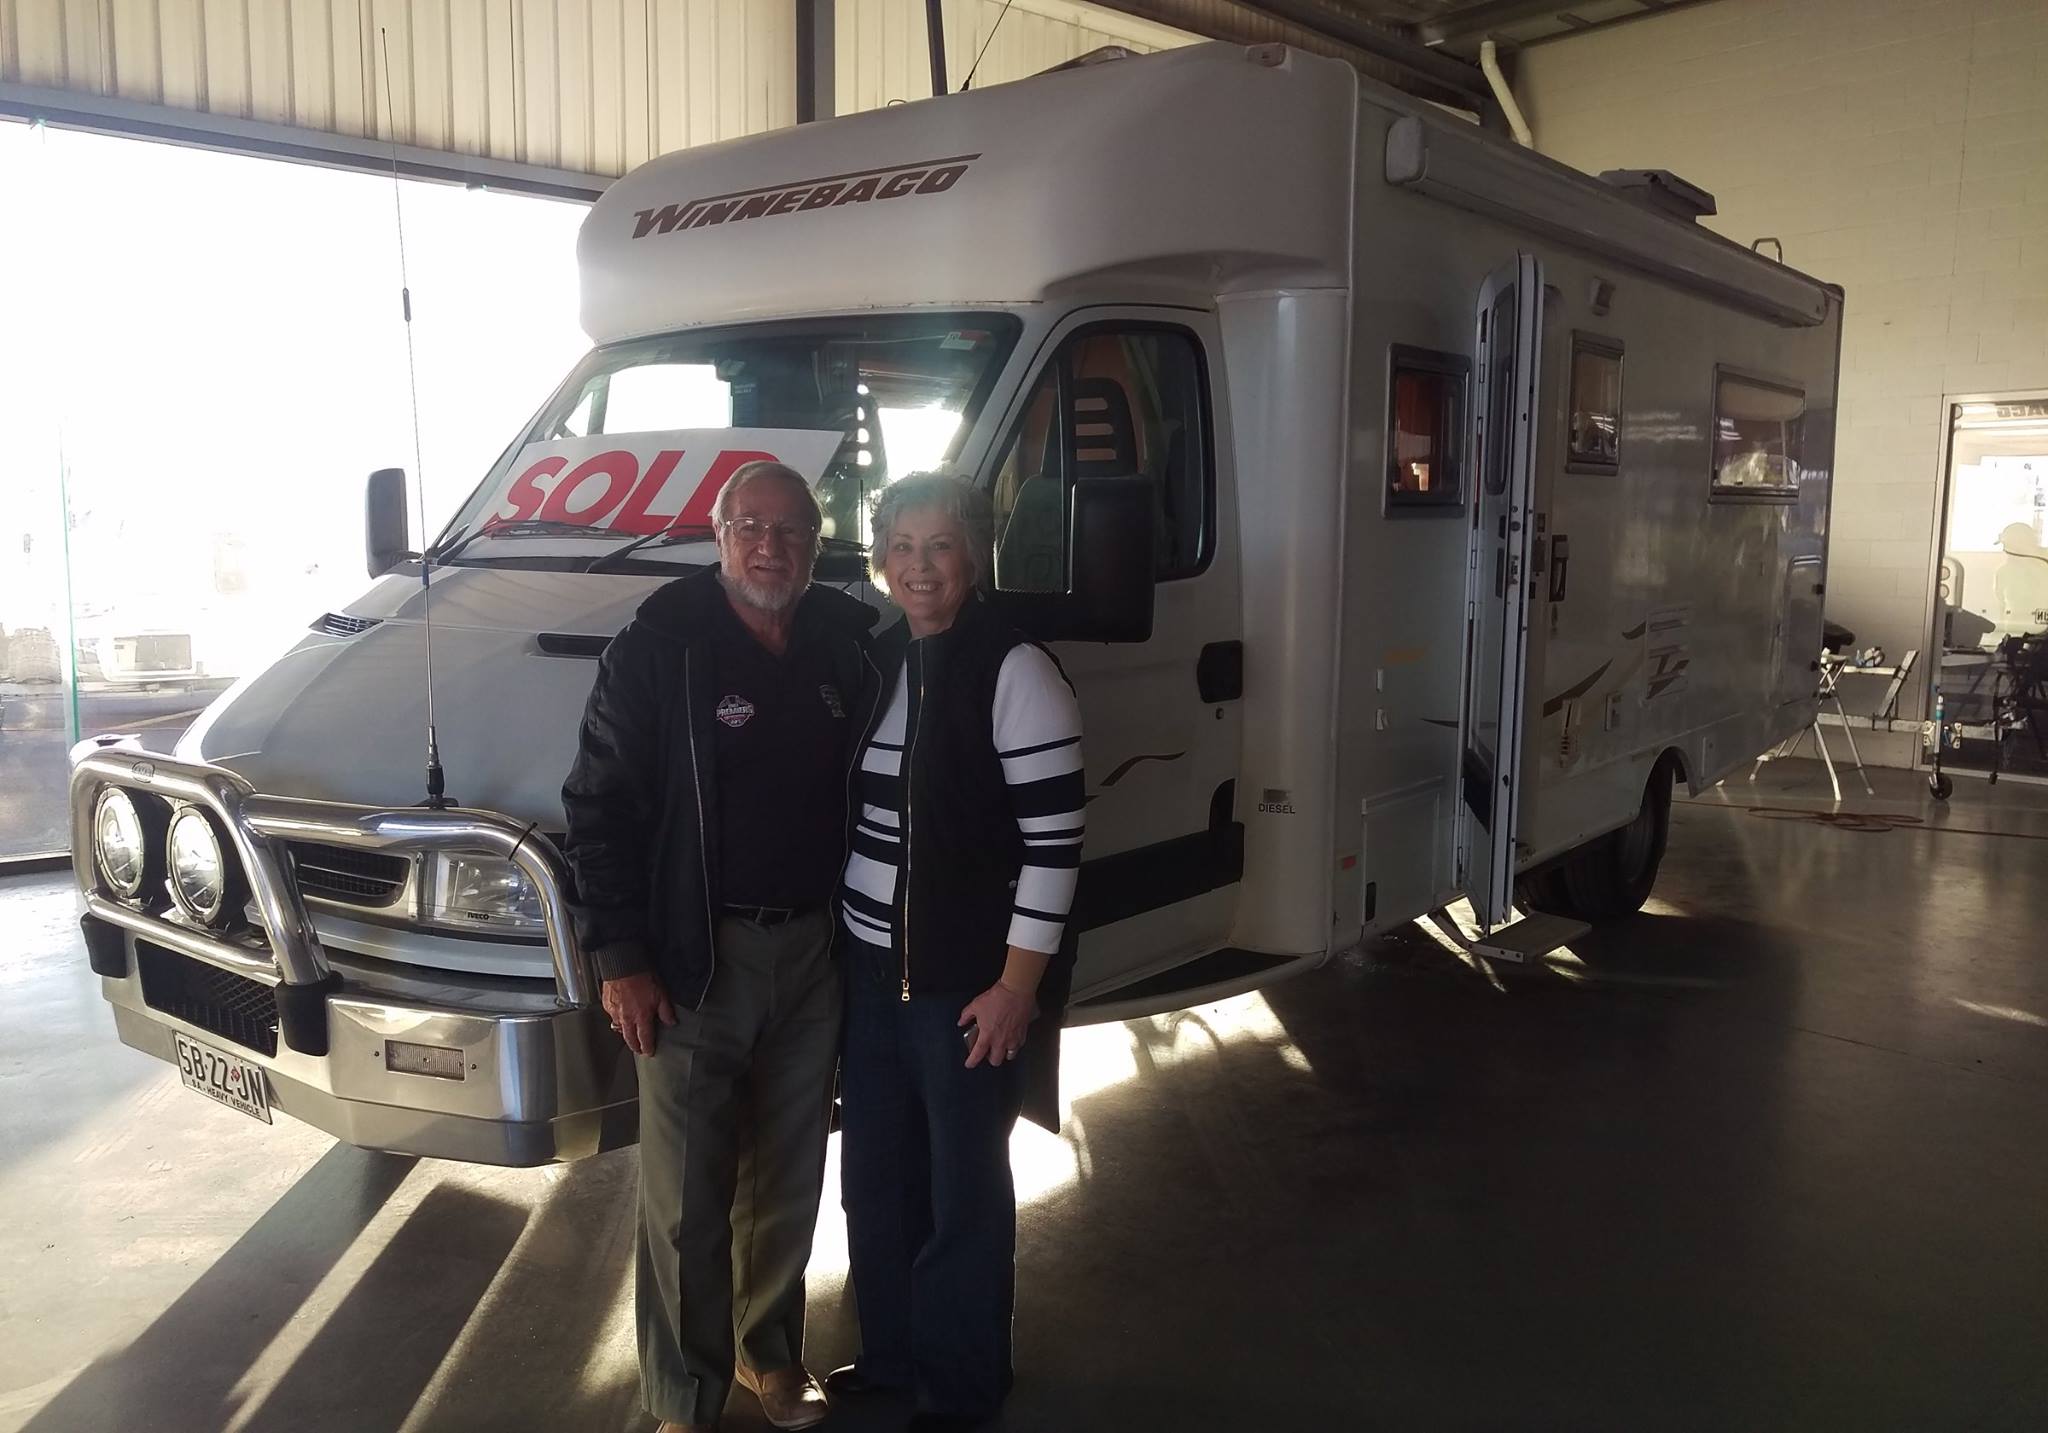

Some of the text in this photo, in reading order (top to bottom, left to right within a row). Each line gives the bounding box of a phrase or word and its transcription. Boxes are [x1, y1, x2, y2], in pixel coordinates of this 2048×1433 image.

[632, 163, 970, 239] WINNEBAGO
[1258, 803, 1296, 814] DIESEL
[467, 911, 490, 920] IVECO
[207, 1085, 229, 1103] HEAVY
[231, 1096, 261, 1118] VEHICLE
